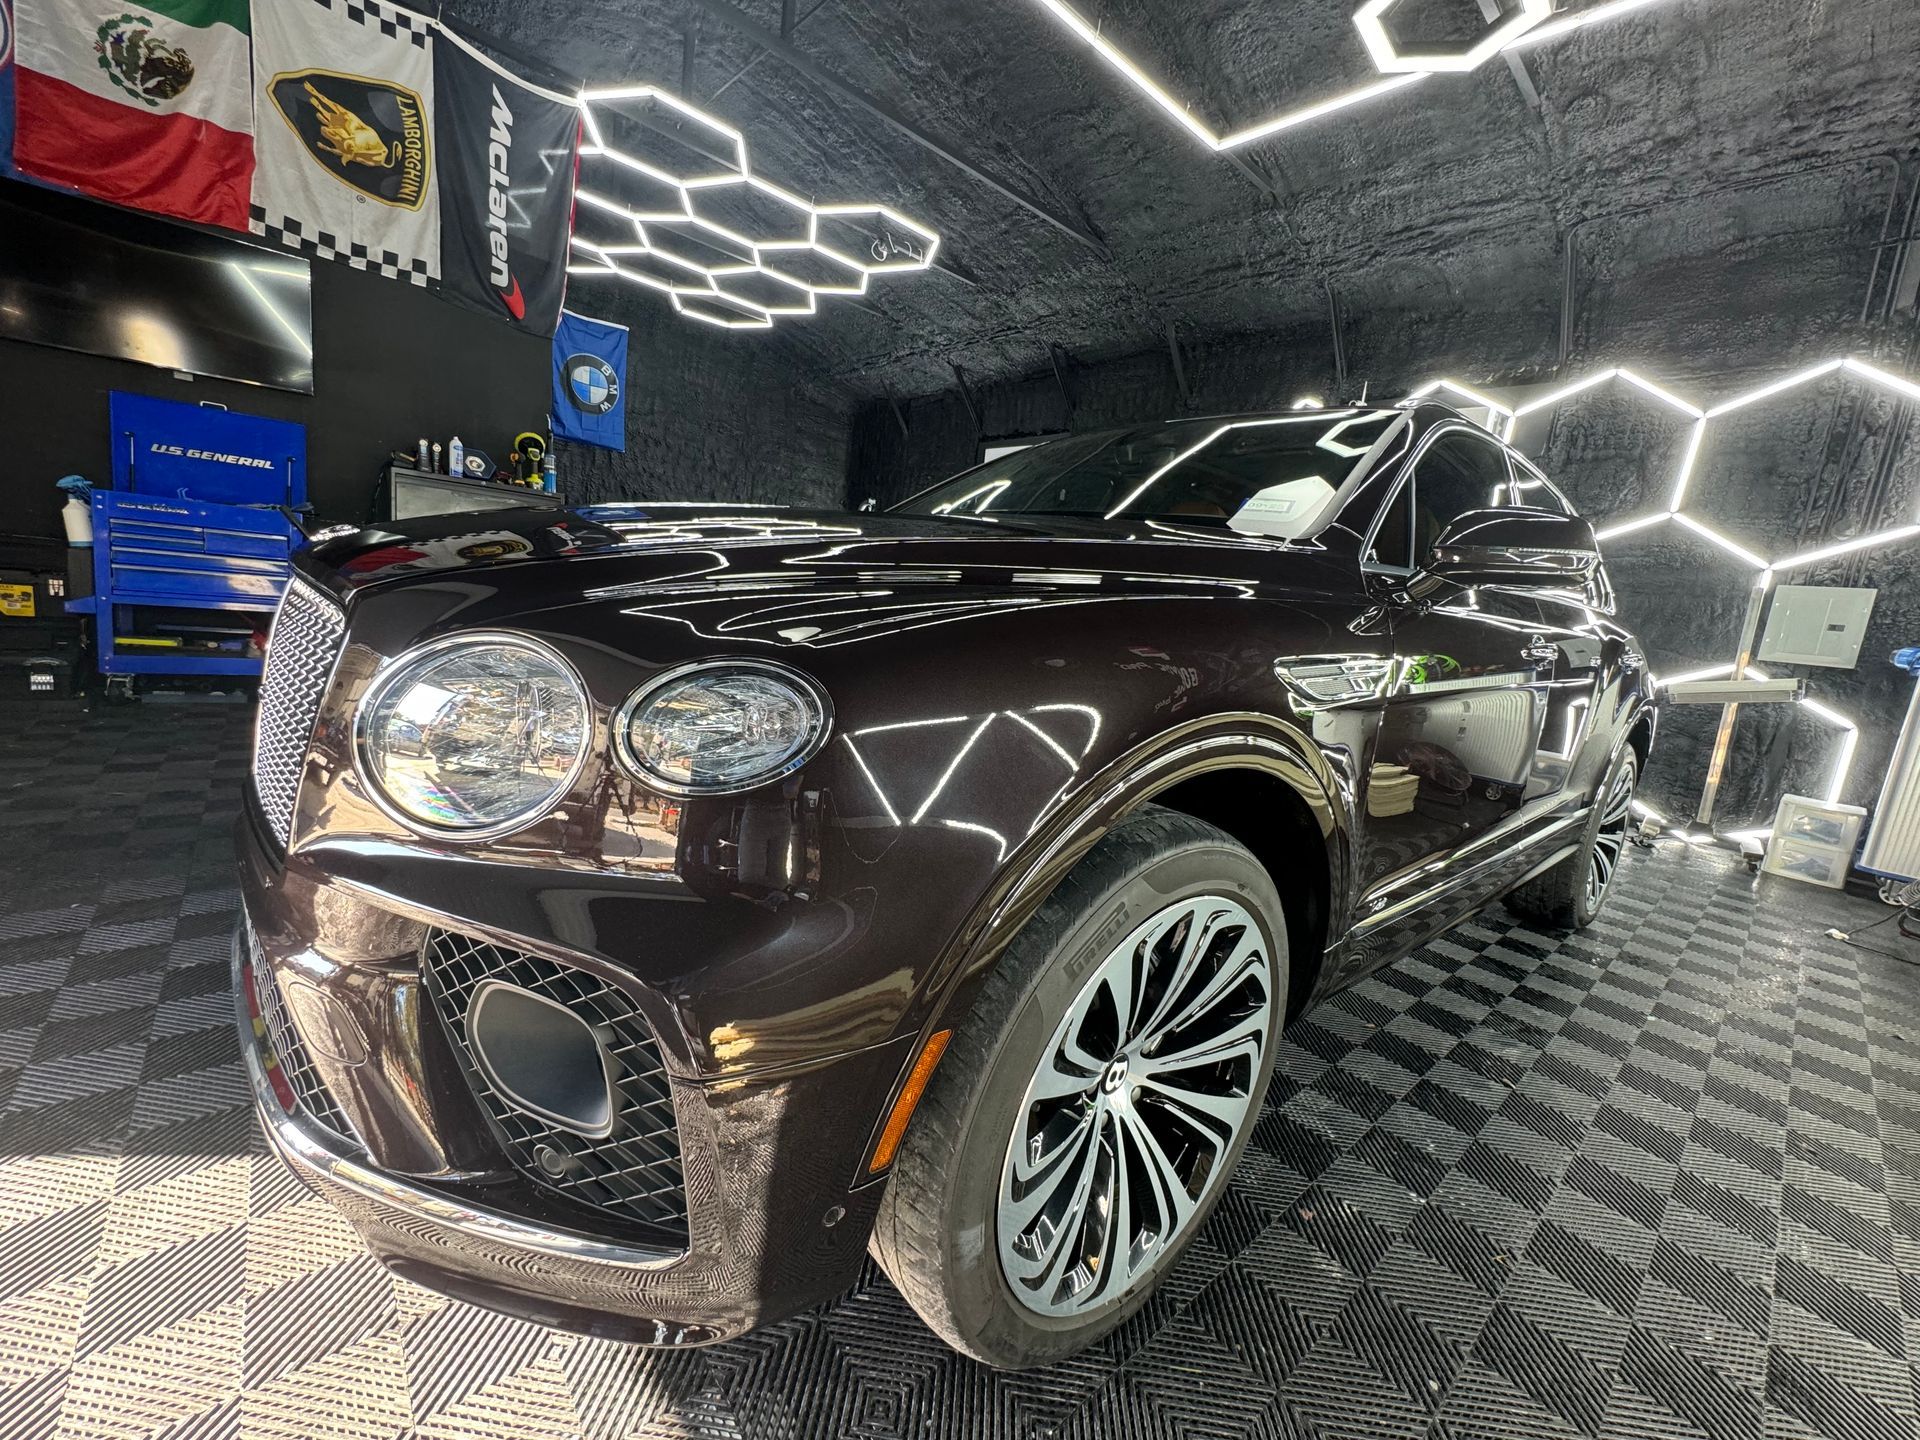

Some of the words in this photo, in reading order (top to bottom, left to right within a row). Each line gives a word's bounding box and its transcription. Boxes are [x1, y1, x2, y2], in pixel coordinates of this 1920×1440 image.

[396, 95, 422, 201] LAMBORGHINI
[489, 83, 514, 288] McLaren
[600, 365, 618, 412] BMW
[186, 449, 275, 470] GENERAL
[1062, 901, 1130, 981] PIRELLI
